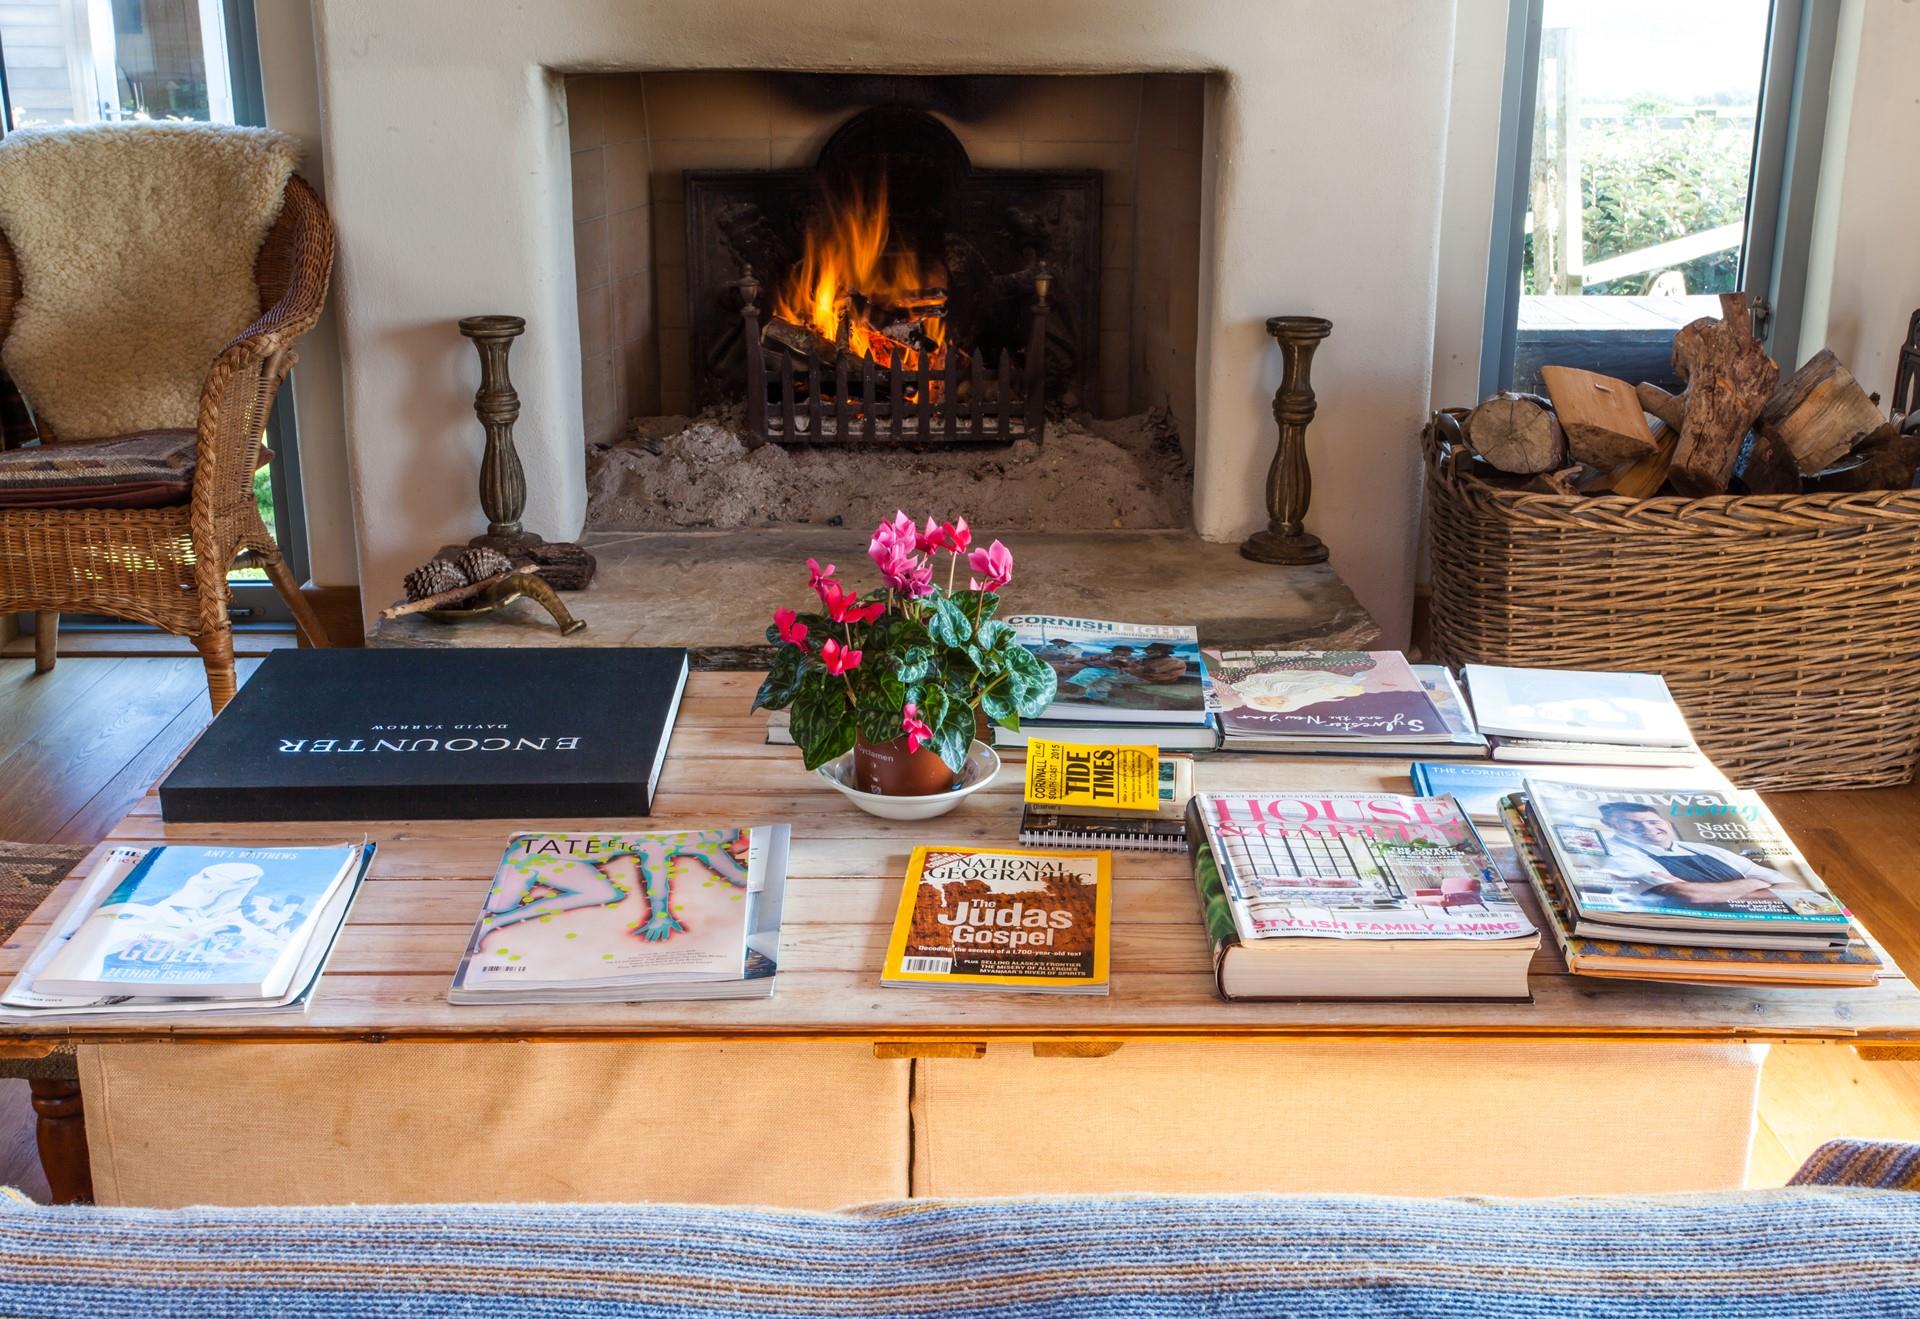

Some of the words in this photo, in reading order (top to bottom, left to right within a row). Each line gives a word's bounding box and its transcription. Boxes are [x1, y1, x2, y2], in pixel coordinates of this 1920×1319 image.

[1007, 616, 1113, 631] CORNISH
[1118, 624, 1189, 636] LIGHT
[371, 723, 444, 731] YARROW
[1284, 715, 1326, 724] New
[1325, 713, 1425, 732] Sylvester
[279, 736, 583, 752] ENCOUNTER
[1050, 744, 1061, 760] 2015
[1034, 760, 1047, 799] CORNWALL
[1049, 764, 1058, 781] COAST
[1066, 751, 1091, 796] TIDE
[1092, 749, 1115, 800] TIMES
[1461, 768, 1522, 777] CORNISH
[1048, 782, 1057, 800] SOUTH
[1213, 799, 1459, 825] HOUSE
[1670, 804, 1759, 821] Living
[1254, 822, 1464, 840] GARDEN
[202, 849, 225, 858] ANT
[238, 851, 299, 860] MATTHEWS
[521, 838, 601, 855] TATE
[956, 857, 1070, 872] NATIONAL
[928, 867, 1092, 883] GEOGRAPHIC
[971, 898, 996, 908] The
[937, 901, 1073, 929] Judas
[1252, 918, 1350, 931] STYLISH
[1356, 921, 1436, 932] FAMILY
[1444, 921, 1521, 932] LIVING
[952, 924, 1054, 948] Gospel
[918, 945, 952, 953] Decoding
[1012, 949, 1066, 957] 1,700-year-old
[161, 968, 214, 980] ISLAND
